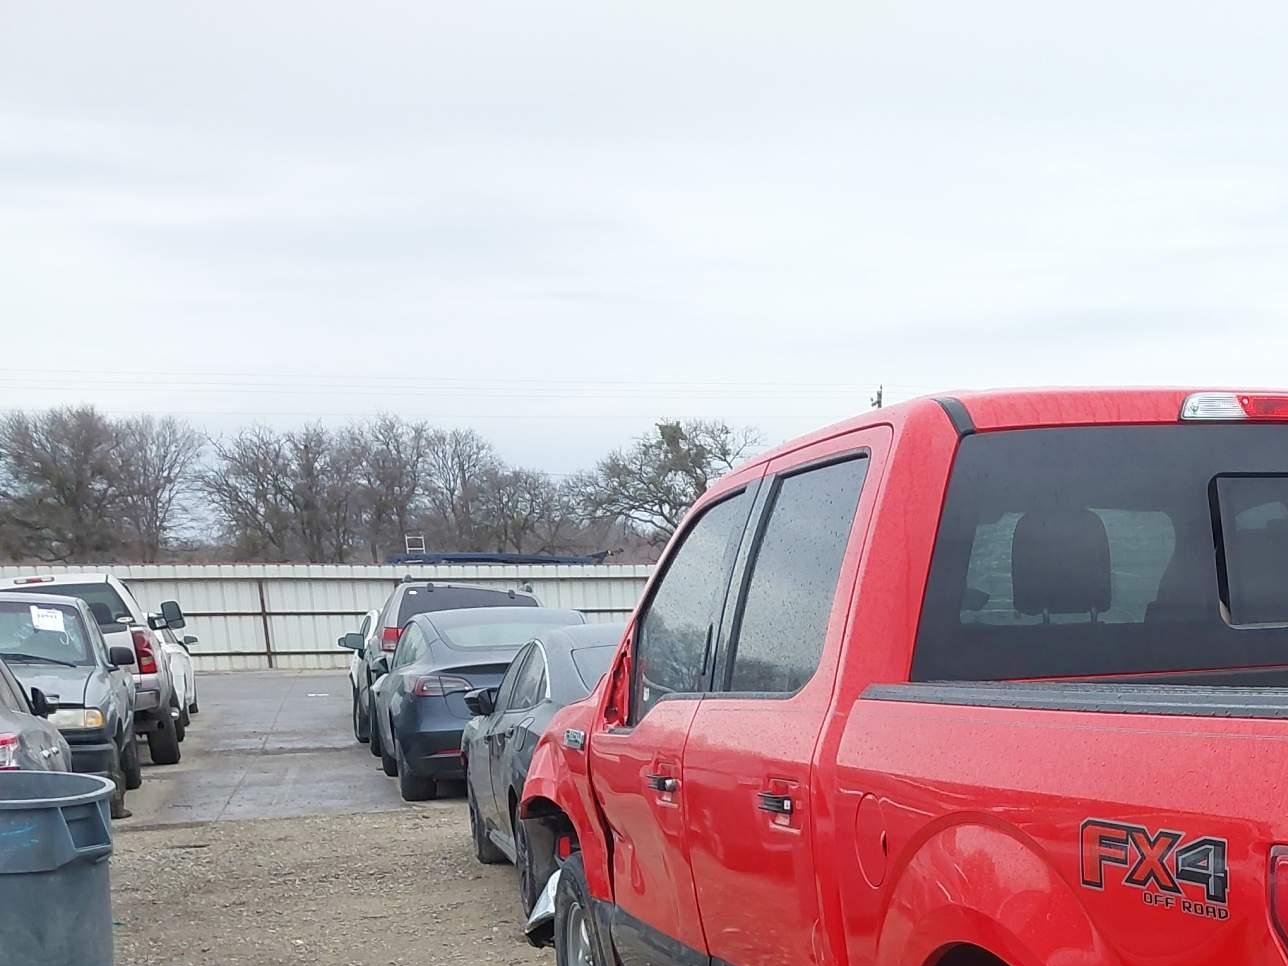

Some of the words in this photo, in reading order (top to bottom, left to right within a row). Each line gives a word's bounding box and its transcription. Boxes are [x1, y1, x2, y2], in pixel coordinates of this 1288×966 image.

[1080, 817, 1230, 906] FX4
[1143, 891, 1177, 910] OFF
[1182, 899, 1230, 921] ROAD
